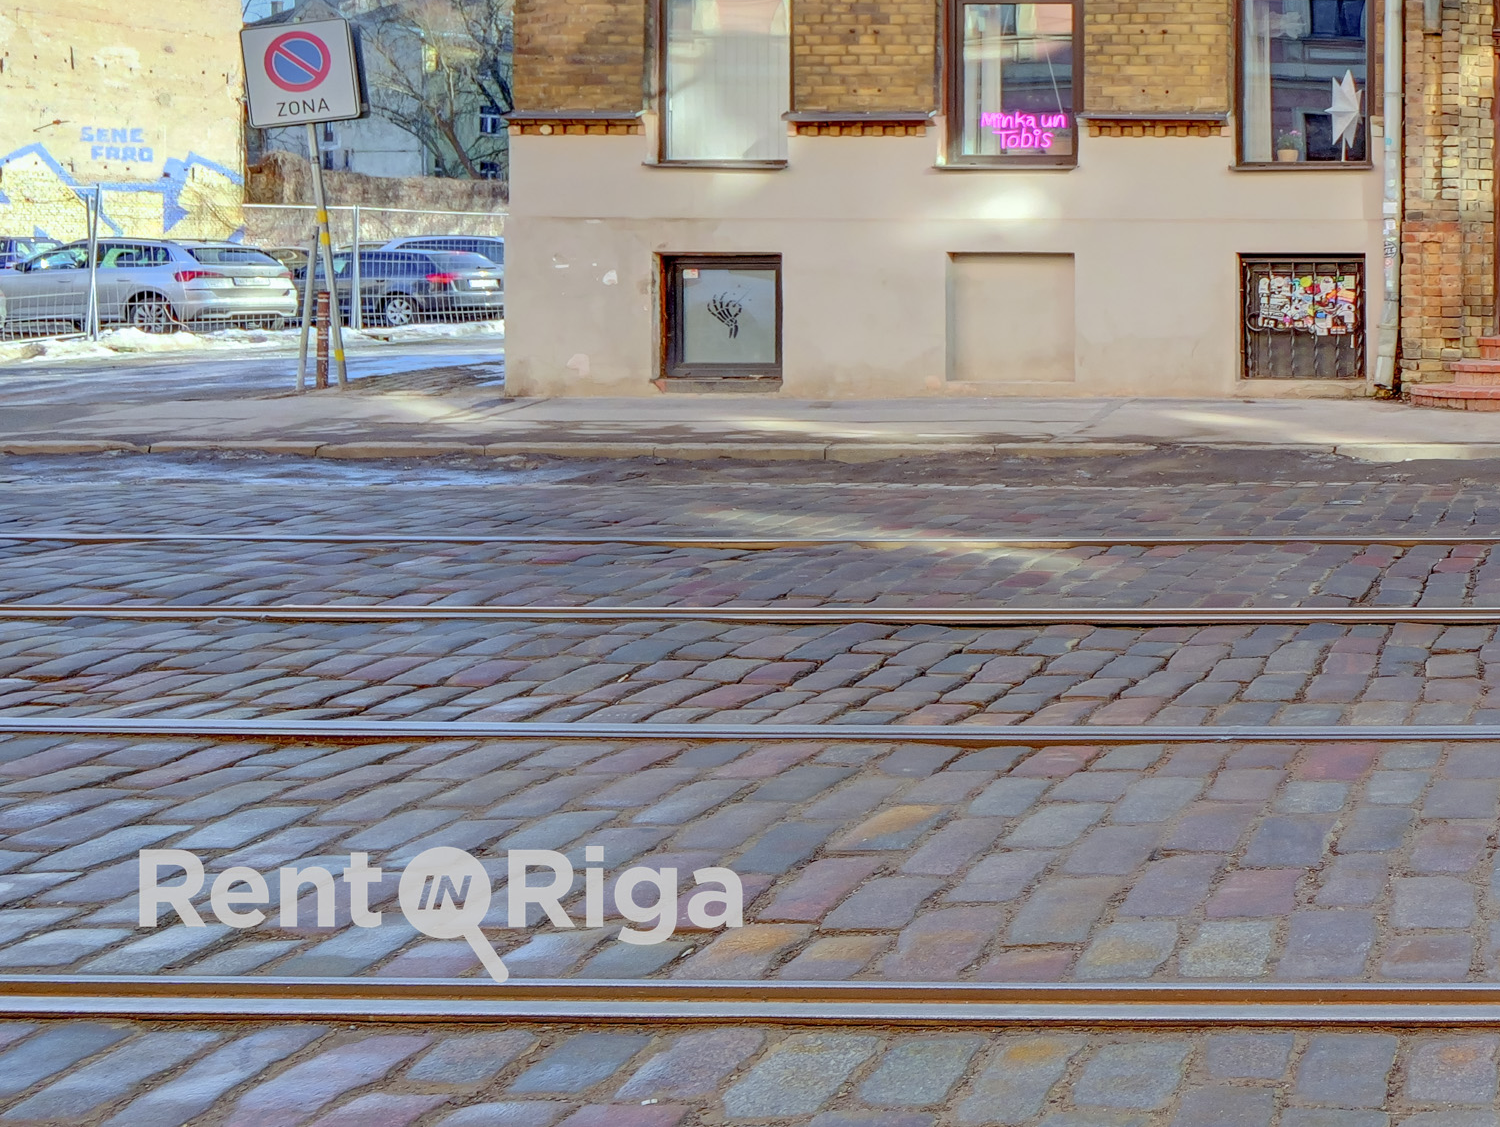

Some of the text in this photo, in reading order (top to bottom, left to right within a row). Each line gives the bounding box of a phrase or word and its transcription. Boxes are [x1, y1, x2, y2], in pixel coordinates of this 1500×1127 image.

[276, 97, 330, 117] ZONA
[980, 111, 1067, 129] Minka un
[991, 127, 1054, 150] Tobis
